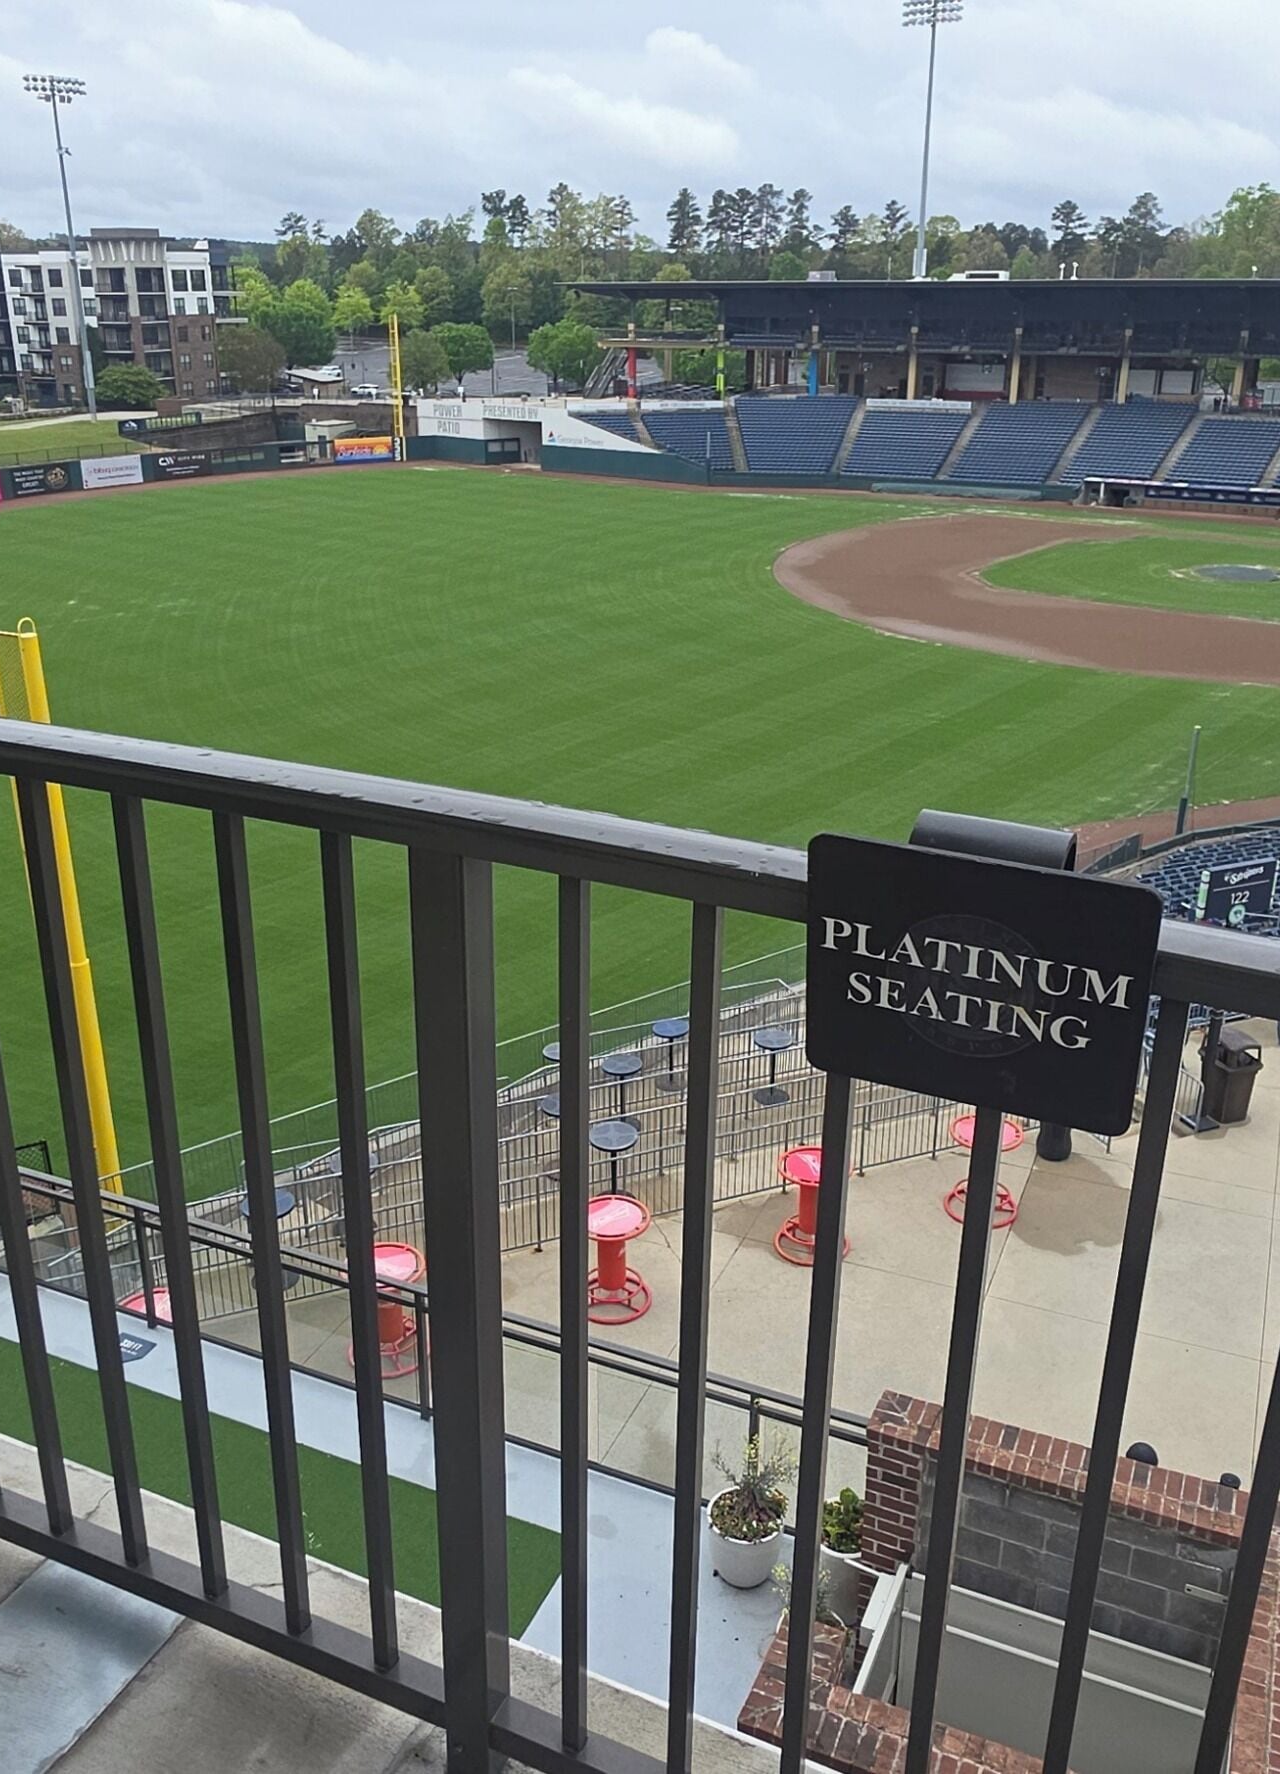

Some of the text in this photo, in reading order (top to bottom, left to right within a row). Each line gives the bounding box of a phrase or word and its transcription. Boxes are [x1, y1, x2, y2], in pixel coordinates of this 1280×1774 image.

[433, 404, 462, 418] POWER
[483, 404, 526, 419] PRESENTED
[438, 420, 460, 435] PATIO
[1230, 890, 1251, 905] 122
[820, 915, 1135, 1010] PLATINUM
[846, 971, 1092, 1050] SEATING
